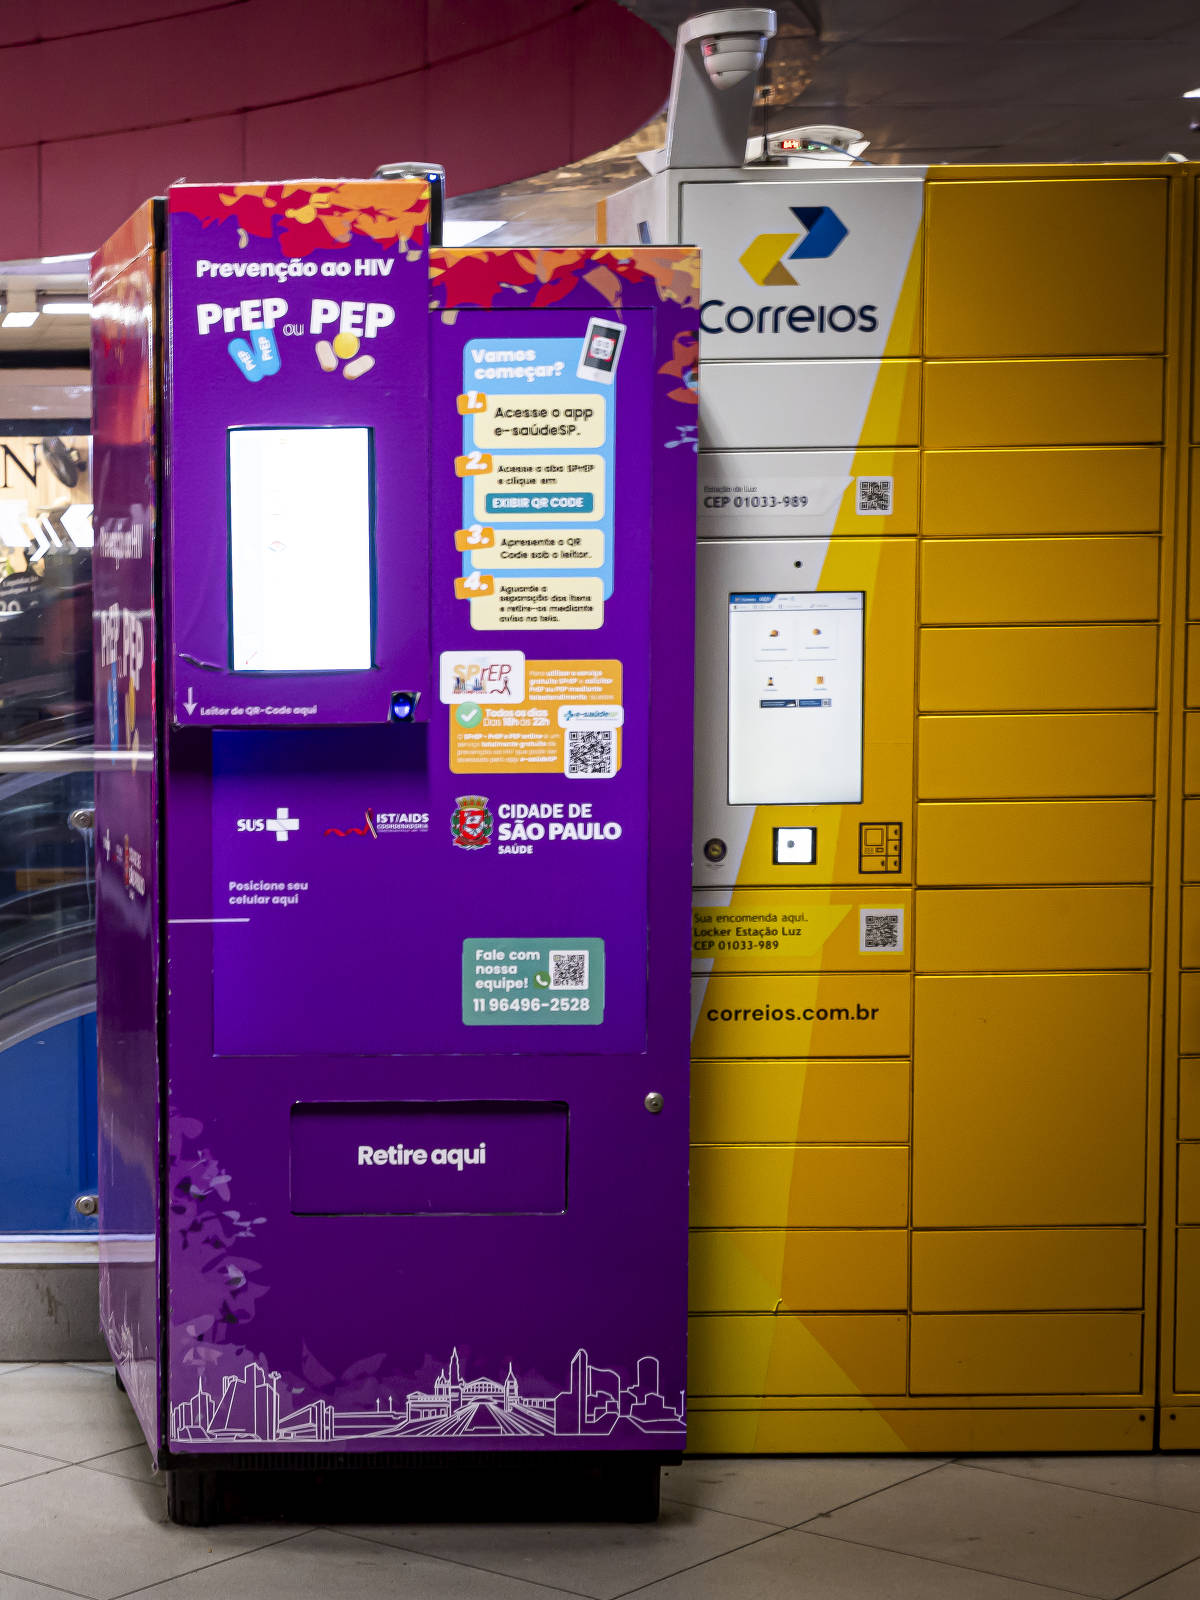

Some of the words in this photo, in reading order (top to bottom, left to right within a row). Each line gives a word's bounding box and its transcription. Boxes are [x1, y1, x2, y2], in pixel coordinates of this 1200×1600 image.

[196, 257, 318, 283] Prevenção
[321, 261, 351, 277] ao
[355, 258, 394, 276] HIV
[196, 297, 289, 335] PrEP
[283, 324, 304, 336] ou
[310, 298, 395, 338] PEP
[700, 300, 879, 334] Correios
[471, 349, 536, 363] Vamos
[474, 361, 565, 382] começar?
[467, 390, 483, 409] 1.
[495, 407, 548, 418] Acesse
[552, 409, 560, 418] o
[565, 409, 593, 422] app
[495, 424, 581, 436] e-saúdeSP.
[466, 451, 488, 470] 2.
[498, 465, 533, 473] Acesse
[506, 477, 536, 487] clique
[492, 497, 529, 508] EXIBIR
[531, 497, 548, 509] QR
[550, 496, 584, 507] CODE
[704, 496, 731, 508] CEP
[733, 495, 809, 508] 01033-989
[466, 524, 490, 545] 3.
[501, 538, 555, 547] Apresente
[567, 538, 582, 547] QR
[500, 551, 528, 559] Code
[531, 550, 549, 559] sob
[464, 570, 488, 591] 4.
[200, 705, 230, 716] Leitor
[245, 705, 292, 716] QR-Code
[293, 705, 317, 718] aqui
[498, 803, 563, 819] CIDADE
[569, 803, 593, 818] DE
[376, 813, 430, 823] IST/AIDS
[237, 819, 265, 832] SUS
[497, 820, 545, 841] SÃO
[549, 821, 623, 840] PAULO
[498, 843, 534, 854] SAÚDE
[229, 880, 285, 891] Posicione
[287, 882, 308, 891] seu
[229, 894, 270, 905] celular
[272, 894, 299, 906] aqui
[694, 913, 712, 923] Sua
[716, 913, 777, 923] encomenda
[781, 913, 808, 924] aqui.
[694, 927, 731, 937] Locker
[736, 927, 778, 937] Estação
[782, 927, 802, 936] Luz
[694, 941, 714, 950] CEP
[718, 940, 779, 950] 01033-989
[475, 949, 507, 961] Fale
[509, 951, 540, 961] com
[475, 964, 518, 975] nossa
[475, 977, 528, 992] equipe!
[473, 999, 485, 1011] 11
[489, 998, 590, 1012] 96496-2528
[707, 1004, 879, 1021] correios.com.br
[357, 1143, 428, 1166] Retire
[431, 1142, 486, 1171] aqui
